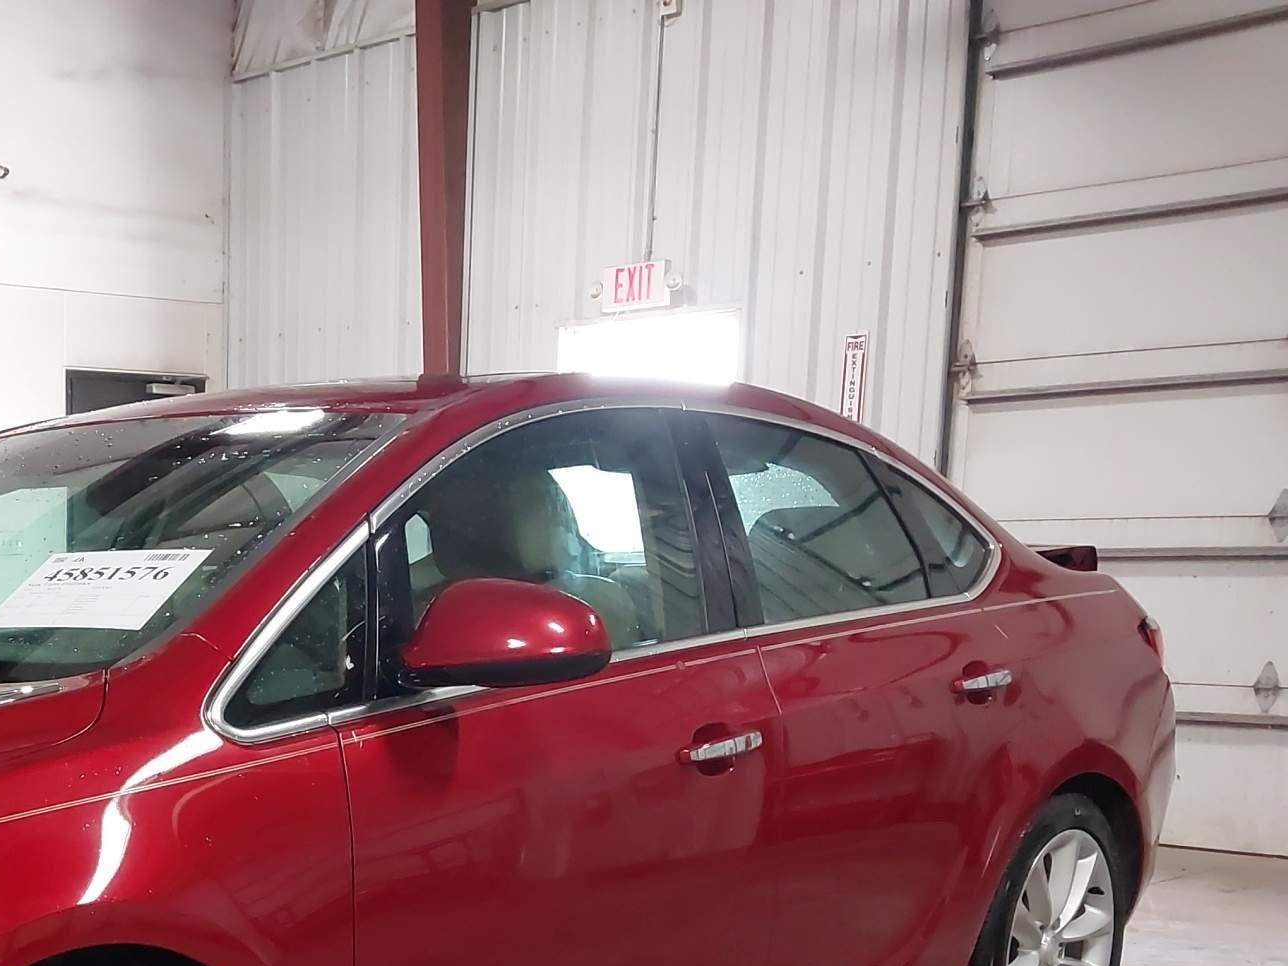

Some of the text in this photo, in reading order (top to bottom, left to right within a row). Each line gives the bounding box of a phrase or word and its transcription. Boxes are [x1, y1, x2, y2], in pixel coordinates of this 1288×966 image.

[614, 263, 655, 304] EXIT
[847, 341, 865, 351] FIRE
[44, 566, 173, 582] 45851576
